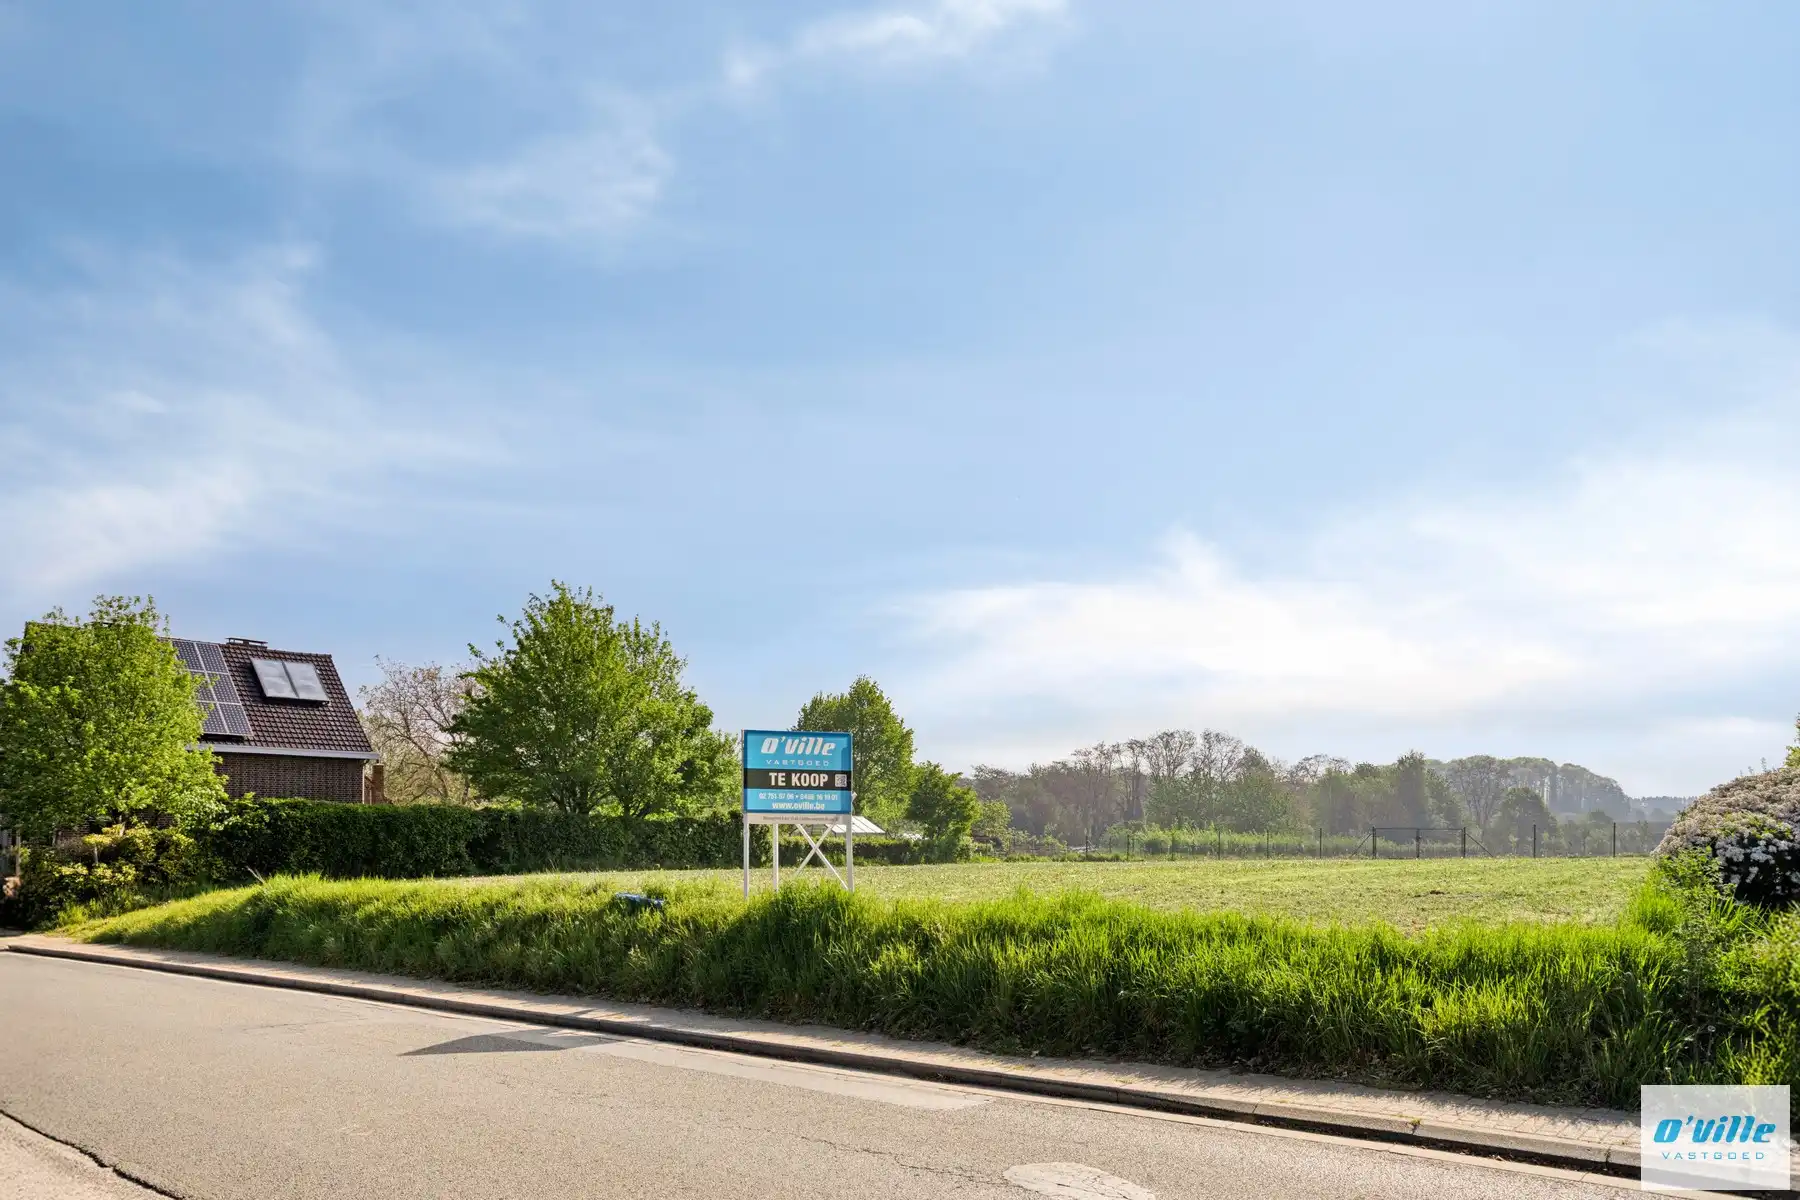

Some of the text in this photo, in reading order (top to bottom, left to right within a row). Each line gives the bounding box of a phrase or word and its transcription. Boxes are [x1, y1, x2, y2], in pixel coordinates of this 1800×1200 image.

[761, 736, 836, 755] O'Ville
[769, 772, 828, 787] TE KOOP
[772, 801, 825, 811] www.oville.be
